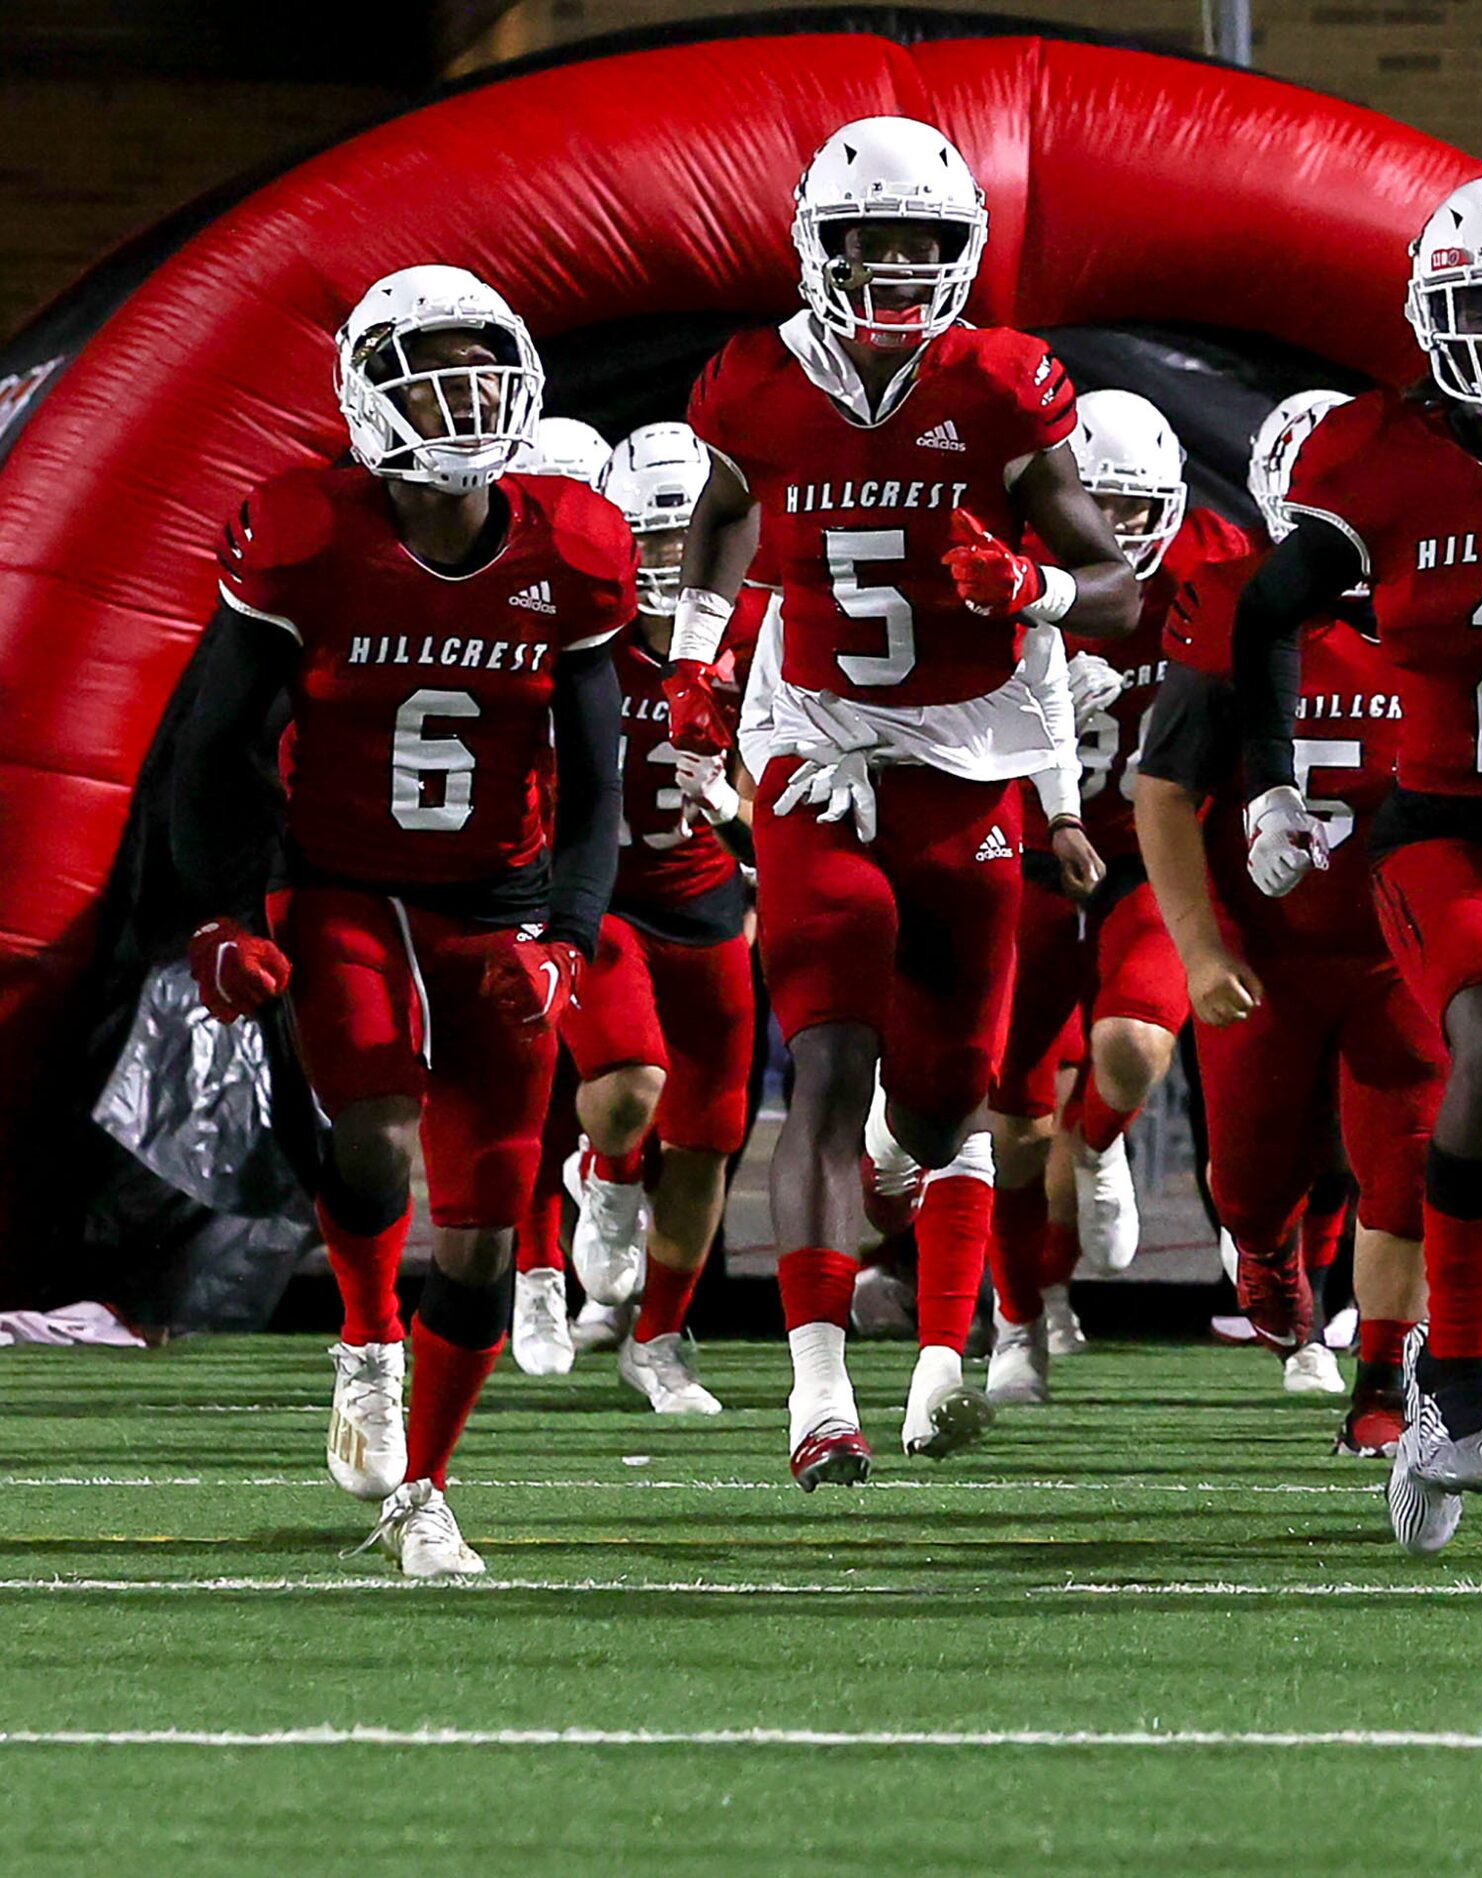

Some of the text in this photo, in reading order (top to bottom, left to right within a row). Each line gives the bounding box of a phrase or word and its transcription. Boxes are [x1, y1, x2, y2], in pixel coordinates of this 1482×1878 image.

[916, 436, 966, 452] adidas
[787, 480, 968, 513] HILLCREST
[508, 595, 557, 614] adidas
[826, 529, 916, 686] 5
[348, 635, 548, 671] HILLCREST
[391, 688, 481, 832] 6
[975, 846, 1014, 862] adidas
